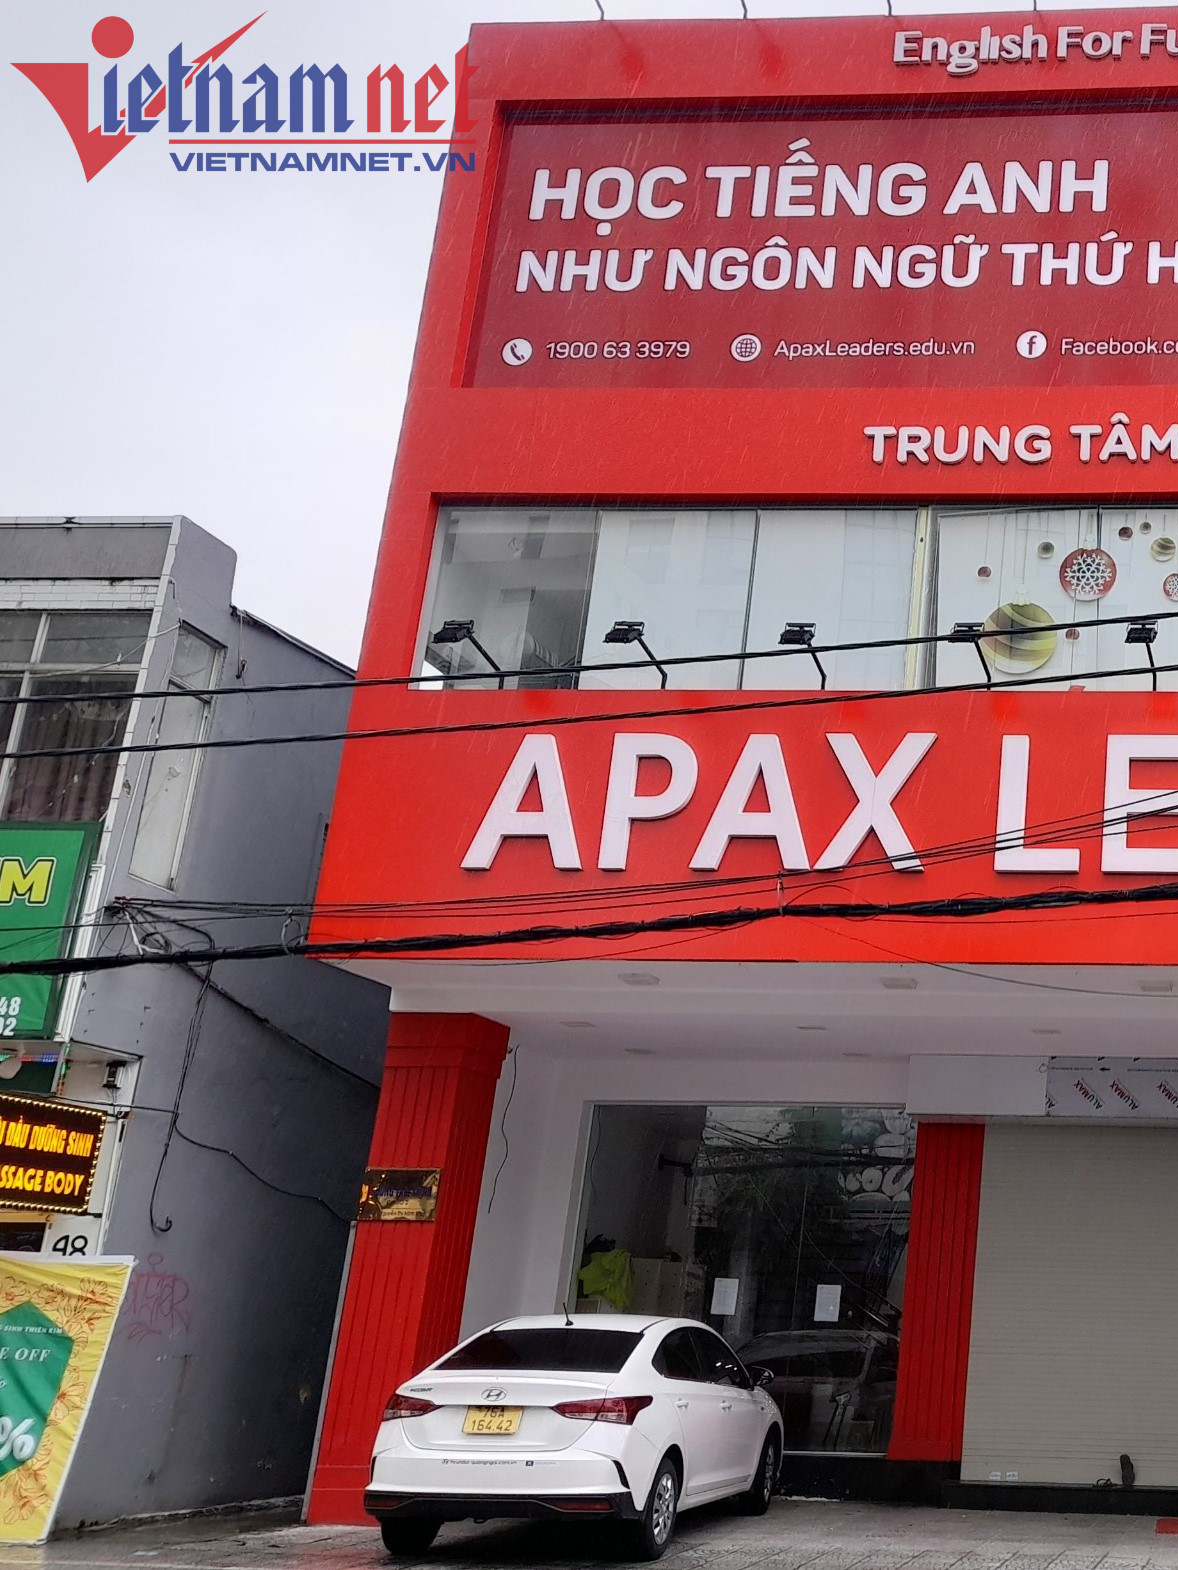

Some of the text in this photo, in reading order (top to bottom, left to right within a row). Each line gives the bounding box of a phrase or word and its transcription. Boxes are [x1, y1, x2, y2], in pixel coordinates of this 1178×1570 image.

[893, 25, 1047, 76] English
[1056, 26, 1133, 60] For
[528, 138, 1108, 235] HỌC TIẾNG ANH
[515, 241, 652, 293] NHƯ
[664, 235, 837, 292] NGÔN
[851, 235, 989, 289] NGỮ
[1002, 230, 1135, 286] THỨ
[545, 340, 690, 359] 1900 63 3979
[774, 338, 975, 360] ApaxLeaders.edu.vn
[863, 424, 1052, 465] TRUNG
[460, 731, 938, 872] APAX
[1074, 1080, 1103, 1110] ALUMAX
[1109, 1080, 1139, 1110] ALUMAX
[67, 1131, 94, 1157] SINH
[0, 1165, 85, 1196] SSAGE BODY
[14, 1347, 51, 1362] OFF
[471, 1419, 513, 1432] 164.42
